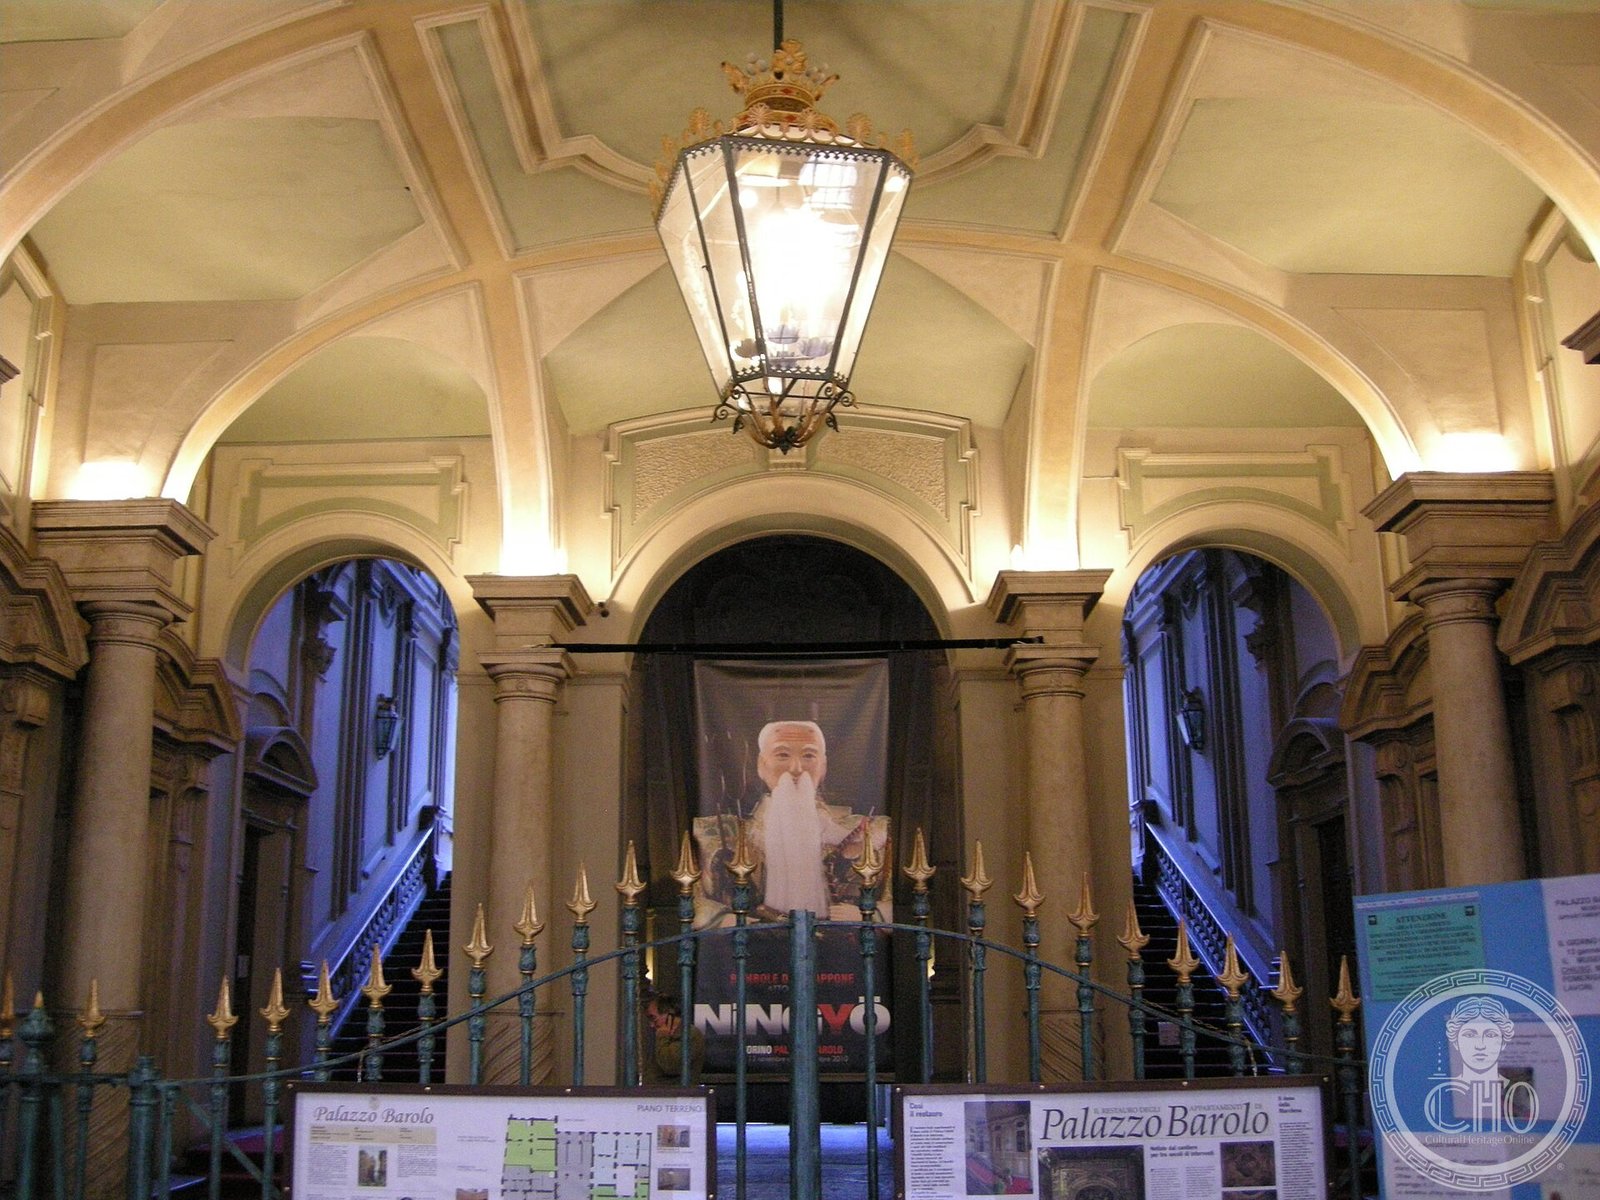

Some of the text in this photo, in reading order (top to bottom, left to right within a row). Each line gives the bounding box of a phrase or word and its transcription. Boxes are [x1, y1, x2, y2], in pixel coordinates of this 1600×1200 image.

[313, 1105, 434, 1124] Palazzo Barolo
[637, 1105, 663, 1113] PIANO
[1040, 1102, 1269, 1140] Palazzo Barolo
